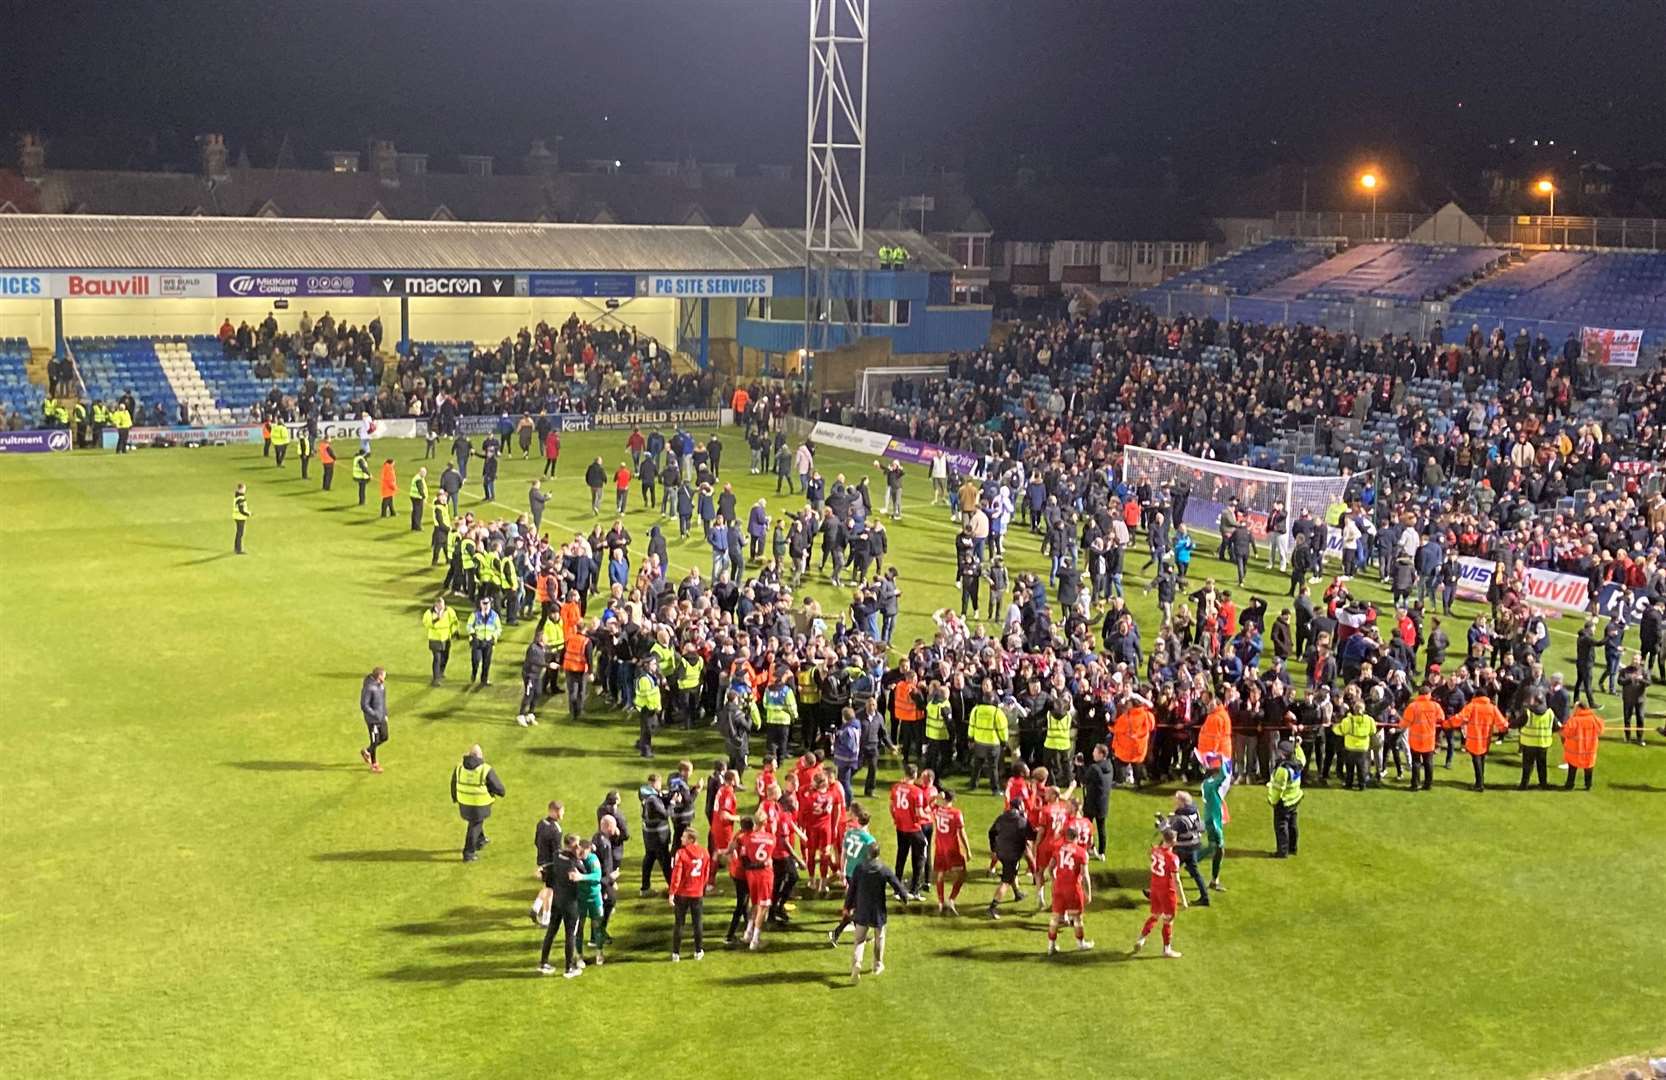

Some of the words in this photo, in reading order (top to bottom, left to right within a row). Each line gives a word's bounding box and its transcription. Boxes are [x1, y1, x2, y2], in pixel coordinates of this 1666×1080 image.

[0, 276, 41, 294] ICES
[68, 275, 150, 295] Bauvill
[256, 277, 299, 286] MidKent
[259, 285, 297, 295] College
[405, 277, 482, 294] macron
[655, 278, 673, 293] PG
[676, 278, 704, 293] SITE
[706, 278, 767, 294] SERVICES
[561, 419, 590, 432] Kent
[594, 411, 668, 425] PRIESTFIELD
[670, 409, 719, 422] STADIUM
[0, 435, 43, 445] ruitment
[208, 430, 249, 438] SUPPLIES
[1528, 578, 1587, 605] uvill
[895, 790, 909, 809] 16
[936, 815, 951, 833] 15
[755, 843, 768, 860] 6
[846, 838, 864, 858] 27
[690, 859, 703, 877] 2
[1060, 850, 1075, 870] 14
[1151, 854, 1166, 877] 23
